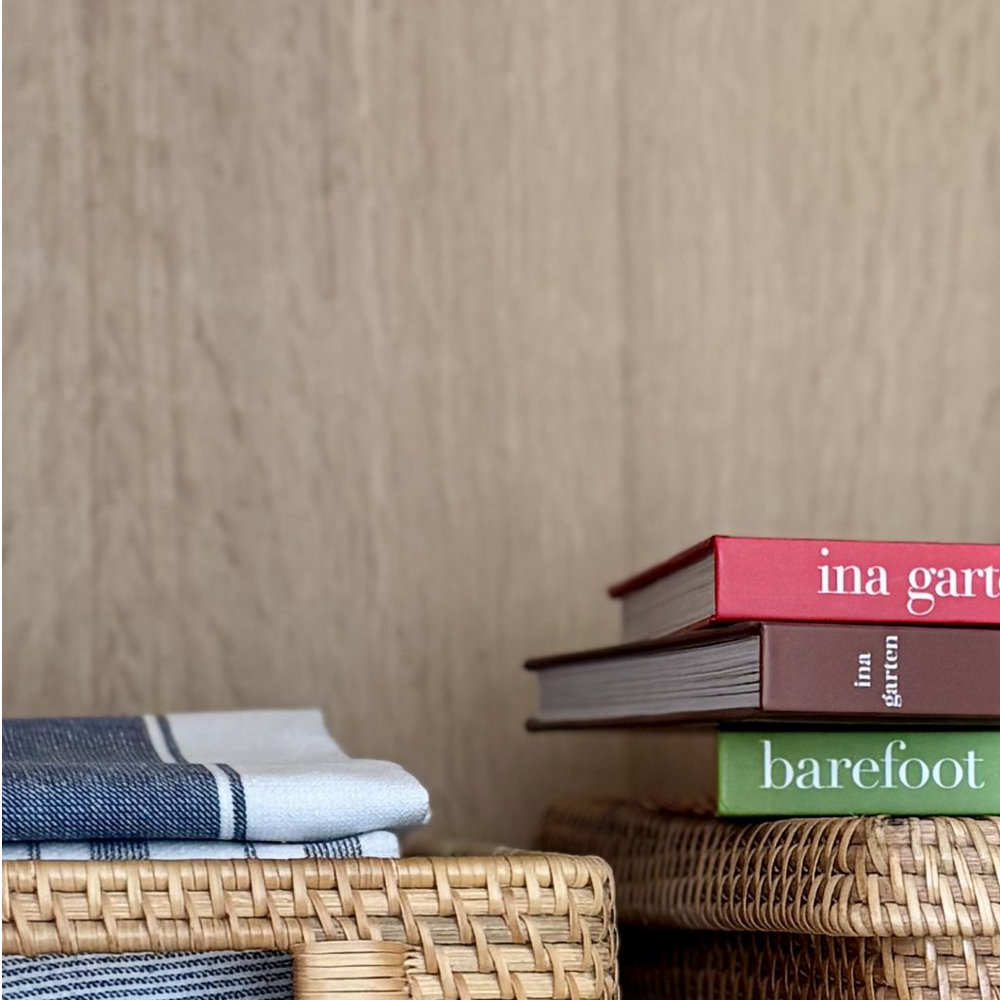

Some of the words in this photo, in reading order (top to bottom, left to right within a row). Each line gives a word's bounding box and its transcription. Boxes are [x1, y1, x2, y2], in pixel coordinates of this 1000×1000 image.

[817, 547, 890, 596] ina
[853, 652, 872, 688] ina
[881, 635, 902, 708] garten
[760, 740, 986, 791] barefoot
